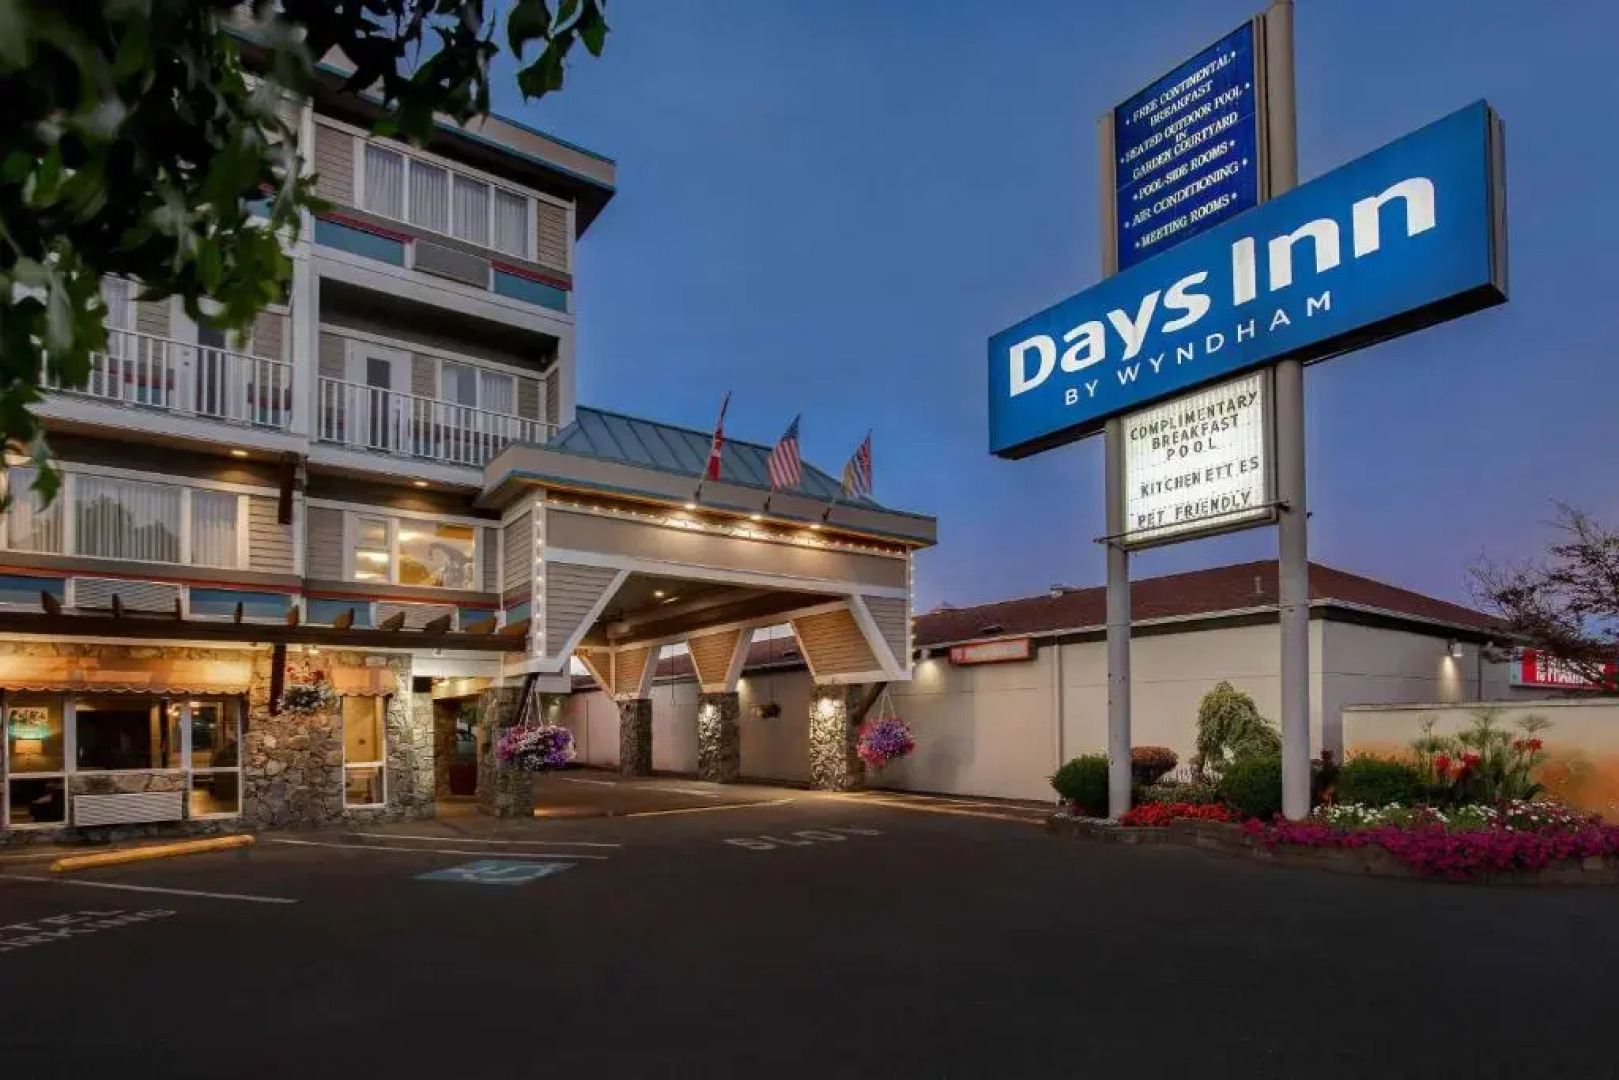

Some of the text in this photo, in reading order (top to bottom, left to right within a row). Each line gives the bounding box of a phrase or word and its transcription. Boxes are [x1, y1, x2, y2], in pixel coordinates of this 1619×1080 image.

[1133, 56, 1232, 123] FREE CONTINENTAL
[1149, 80, 1214, 127] BREAKFAST
[1125, 87, 1243, 163] HEATED OUTDOOR POOL
[1133, 111, 1239, 180] GARDEN COURTYARD
[1175, 130, 1188, 144] IN
[1190, 141, 1229, 168] ROOMS
[1132, 161, 1240, 227] AIR CONDITIONING
[1140, 193, 1230, 248] MEETING ROOMS
[1008, 176, 1437, 398] Days Inn
[1064, 290, 1333, 407] BY WYNDHAM
[1130, 391, 1258, 441] COMPLIMENTARY
[1152, 413, 1239, 450] BREAKFAST
[1166, 437, 1217, 461] POOL
[1137, 490, 1252, 529] PET FRIENDLY
